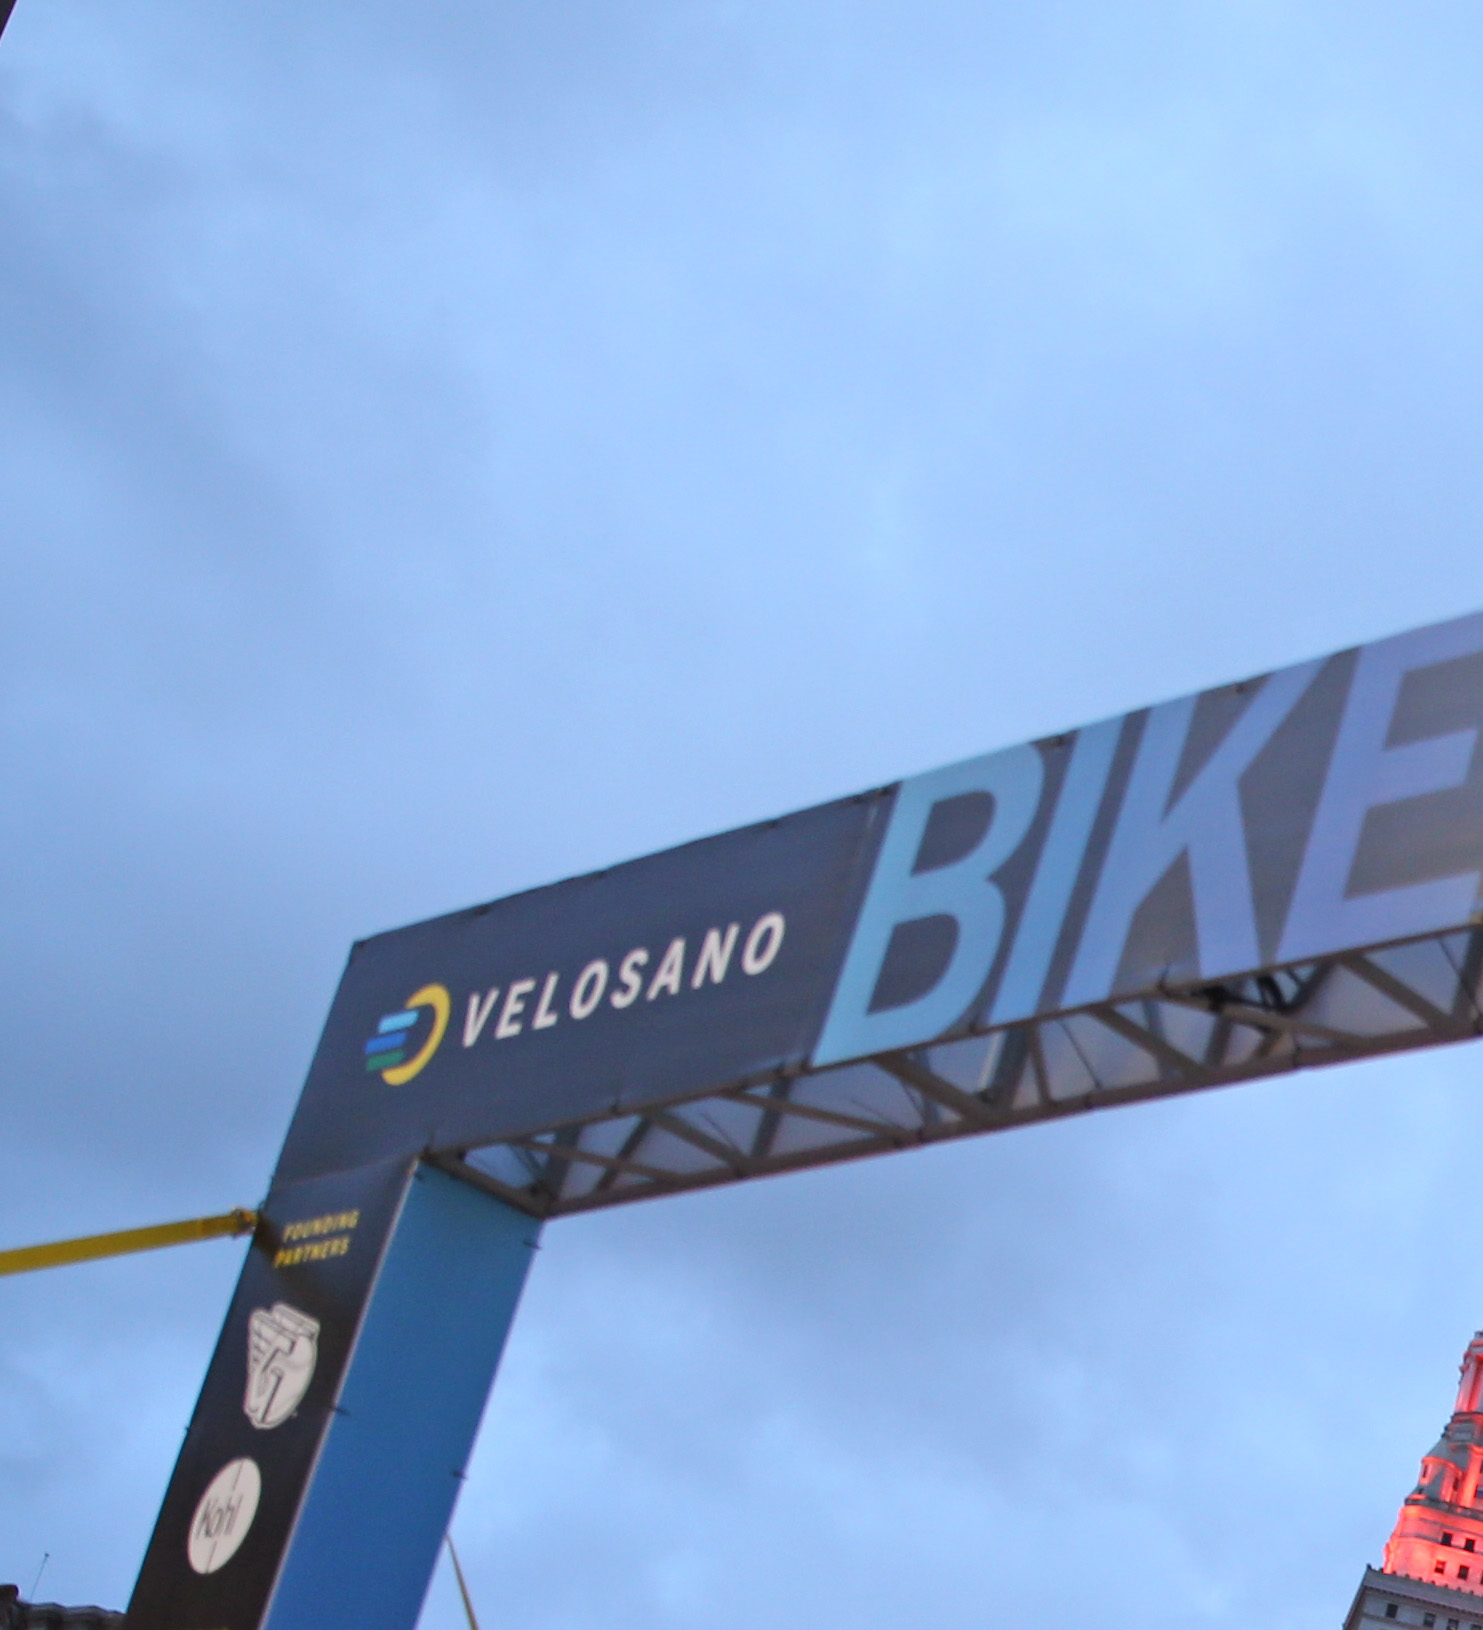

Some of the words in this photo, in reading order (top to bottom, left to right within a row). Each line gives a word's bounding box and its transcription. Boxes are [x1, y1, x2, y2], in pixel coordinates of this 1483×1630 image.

[462, 911, 787, 1049] VELOSANO
[282, 1210, 360, 1244] FOUNDING
[273, 1234, 351, 1269] PARTNERS
